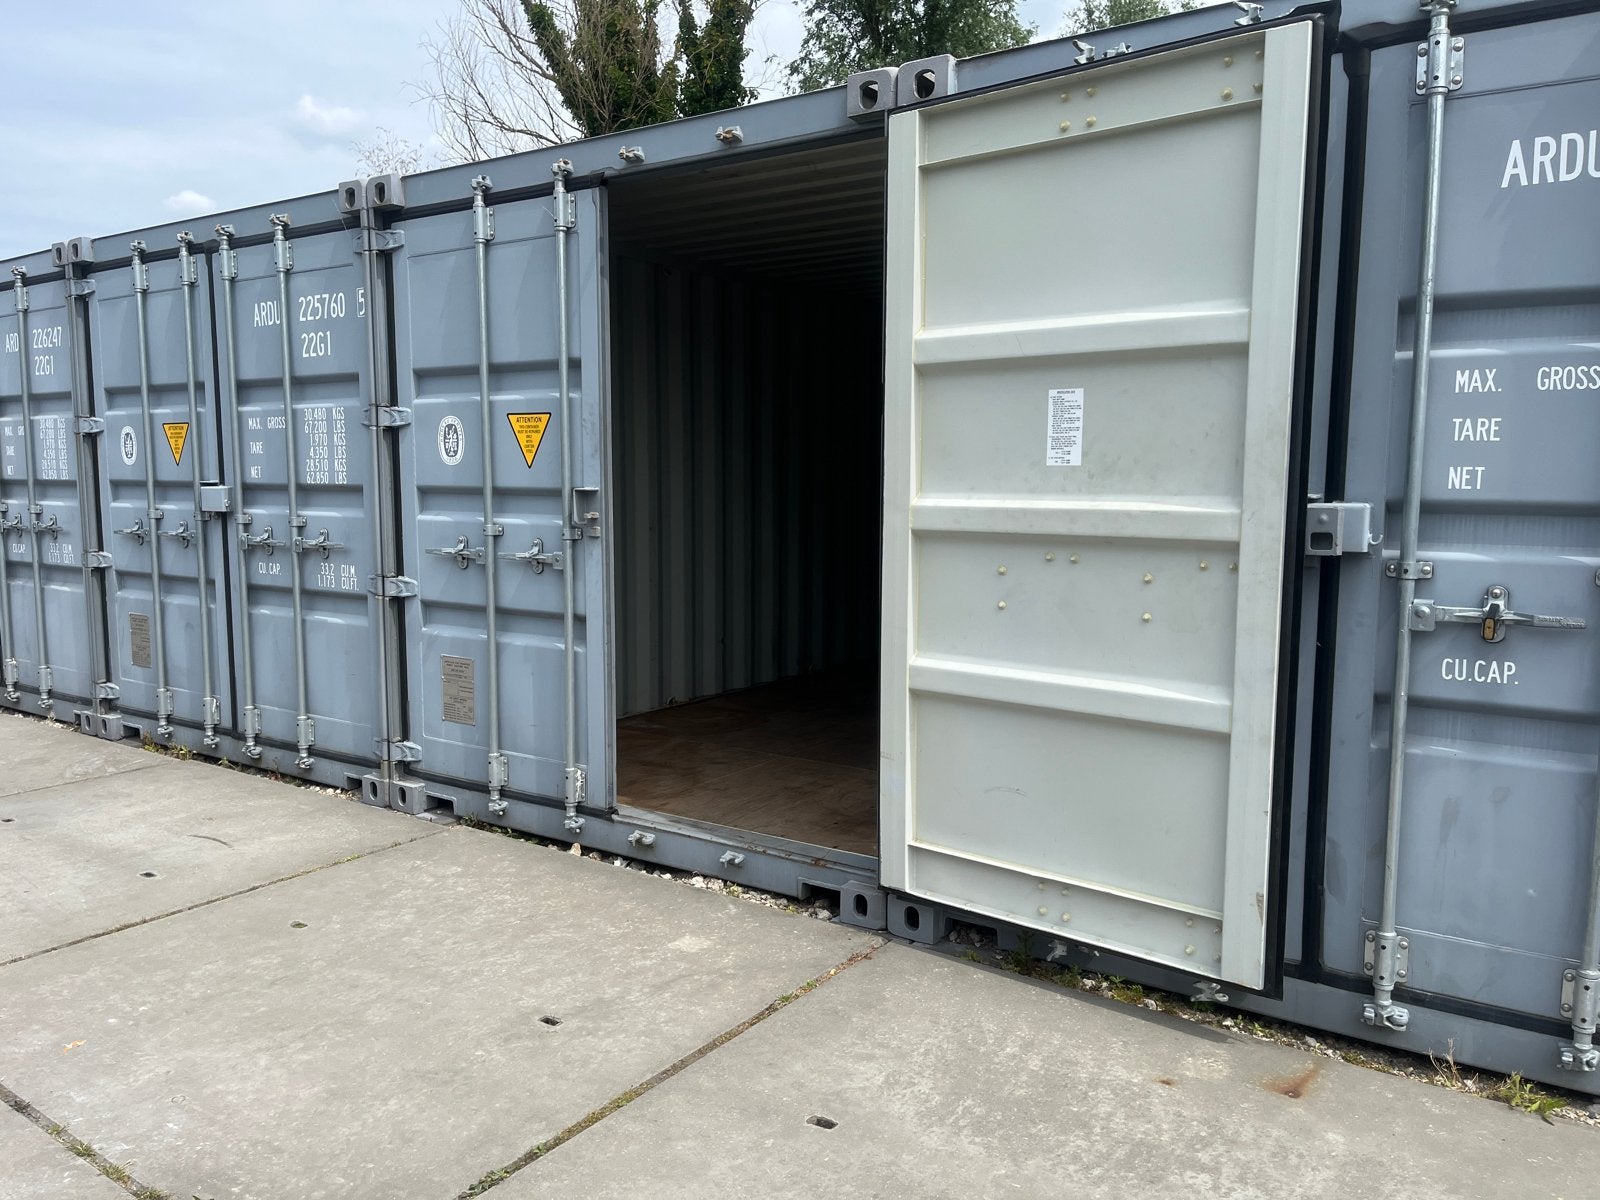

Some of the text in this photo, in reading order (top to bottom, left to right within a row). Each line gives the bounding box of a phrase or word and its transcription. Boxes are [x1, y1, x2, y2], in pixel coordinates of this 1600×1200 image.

[254, 301, 281, 327] ARDU
[299, 293, 345, 321] 225760
[5, 327, 62, 353] ARD 226247
[302, 331, 331, 358] 22G1
[35, 356, 54, 375] 22G1
[1455, 366, 1600, 393] MAX. GROSS
[304, 407, 345, 421] 30.480 KGS
[249, 417, 286, 430] MAX. GROSS
[304, 420, 346, 433] 67.200 LBS
[1453, 418, 1502, 441] TARE
[310, 433, 346, 446] 1.970 KGS
[250, 442, 264, 454] TARE
[310, 446, 347, 459] 4.350 LBS
[251, 466, 262, 478] NET
[306, 459, 347, 472] 28.510 KGS
[306, 472, 347, 484] 62.850 LBS
[1448, 467, 1485, 490] NET
[320, 562, 335, 576] 33.2
[317, 574, 335, 588] 1.173
[1442, 658, 1519, 685] CU.CAP.
